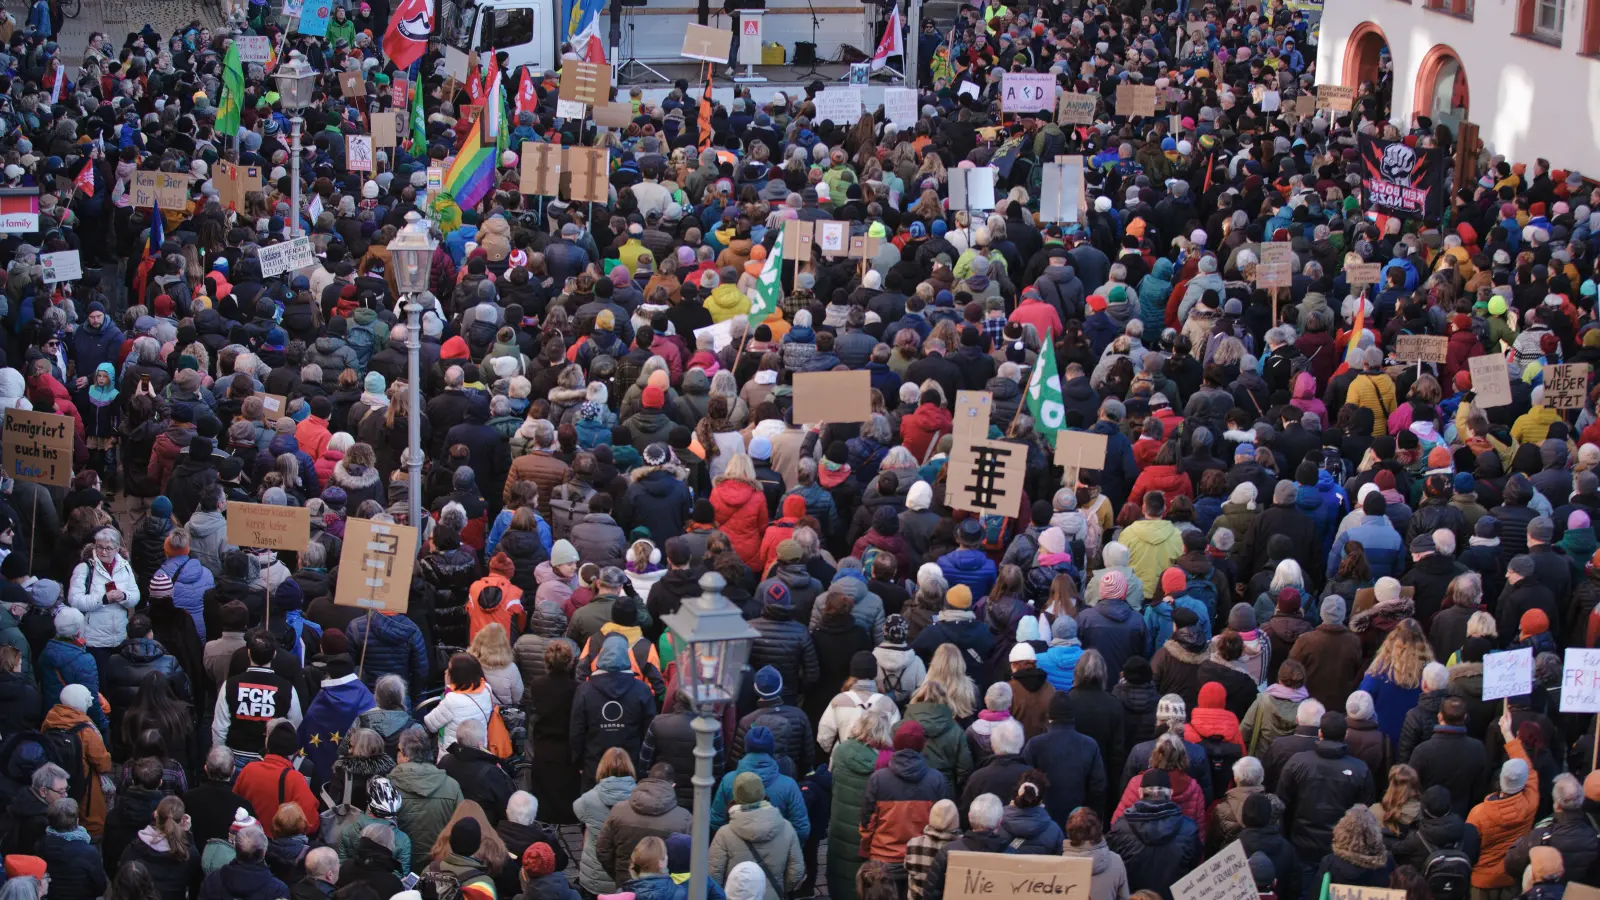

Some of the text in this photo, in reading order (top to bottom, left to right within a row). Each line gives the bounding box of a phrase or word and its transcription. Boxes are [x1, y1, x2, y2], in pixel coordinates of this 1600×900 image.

[137, 172, 182, 189] Kein Bier
[137, 190, 183, 209] für Nazis
[6, 219, 32, 229] family
[1553, 364, 1572, 379] NIE
[1543, 377, 1585, 391] WIEDER
[1543, 394, 1583, 409] JETZT
[6, 415, 65, 439] Remigriert
[15, 441, 58, 460] euch ins
[16, 459, 43, 478] Knie
[237, 687, 277, 705] FCK
[236, 701, 276, 717] AFD
[964, 868, 1077, 895] Nie wieder
